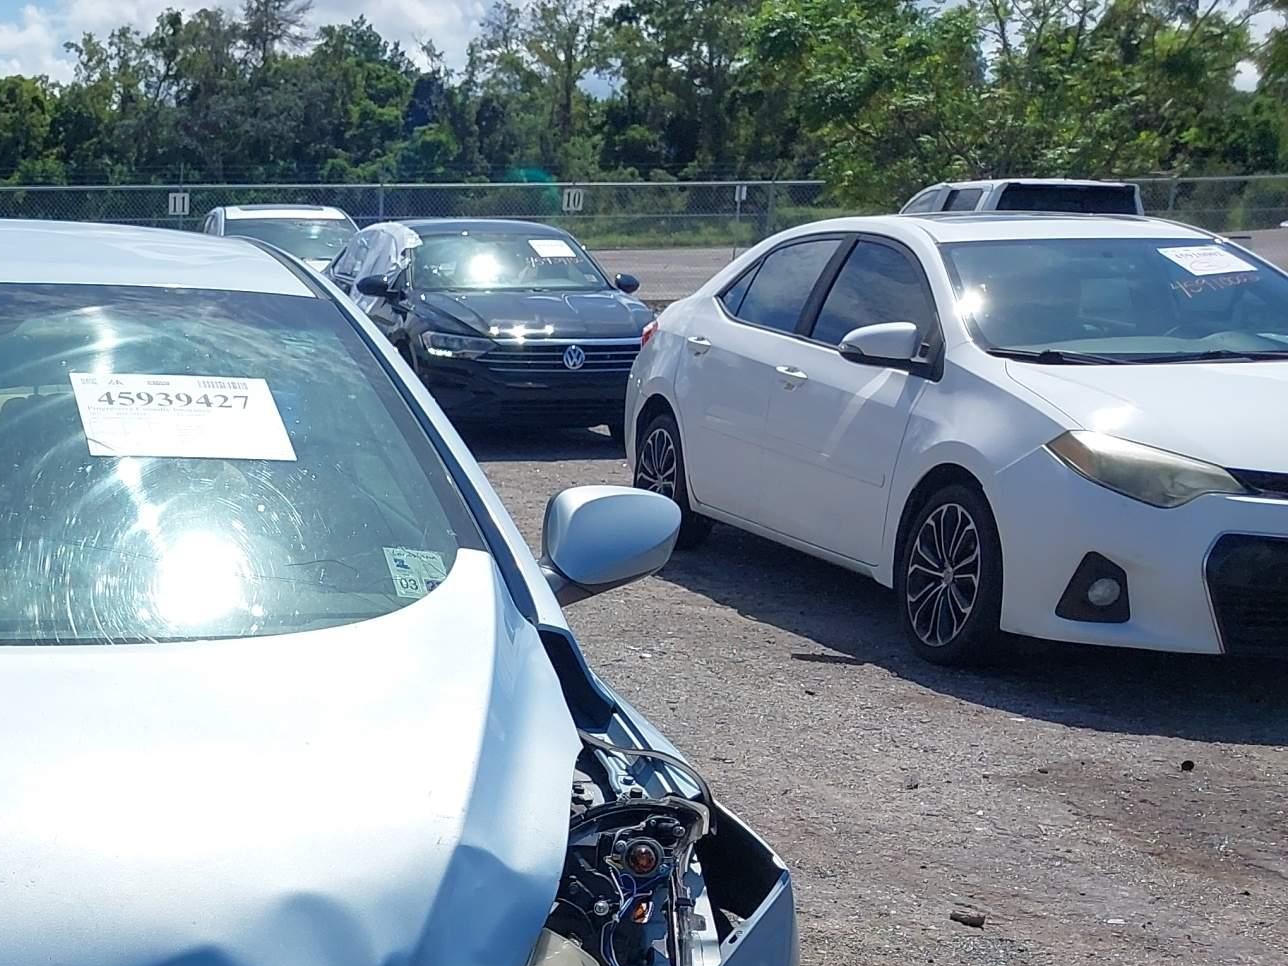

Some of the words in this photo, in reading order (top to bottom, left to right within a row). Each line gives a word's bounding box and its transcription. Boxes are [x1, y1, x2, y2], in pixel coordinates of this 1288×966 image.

[173, 196, 185, 213] 11
[566, 191, 581, 208] 10
[97, 391, 249, 410] 45939427
[400, 578, 418, 591] 03
